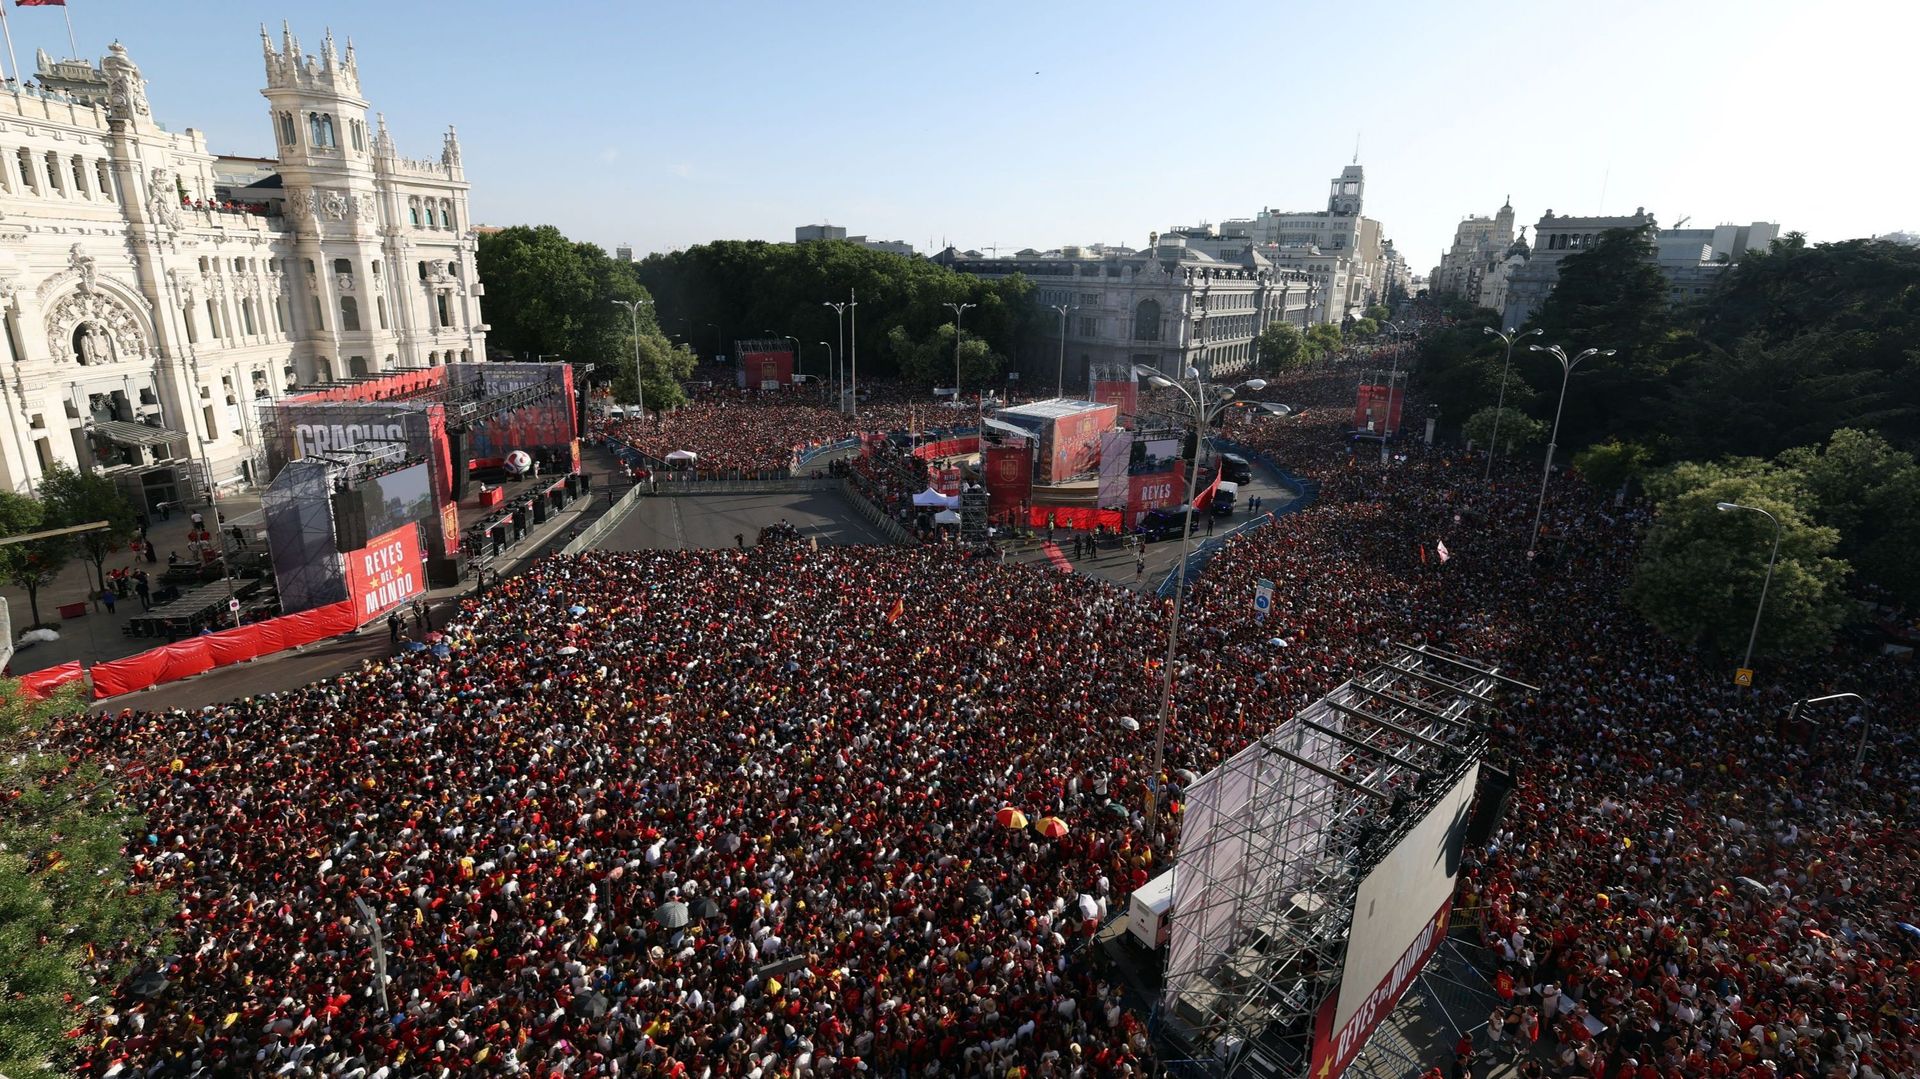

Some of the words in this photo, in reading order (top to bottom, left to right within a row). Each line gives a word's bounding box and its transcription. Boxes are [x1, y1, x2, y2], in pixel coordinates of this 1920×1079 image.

[296, 424, 406, 463] GRACIAS
[1142, 483, 1171, 500] REYES
[364, 541, 404, 576] REYES
[380, 569, 394, 584] DEL
[365, 573, 413, 614] MUNDO
[1335, 988, 1380, 1067] REYES
[1377, 981, 1391, 1005] DEL
[1388, 918, 1436, 1000] MUNDO
